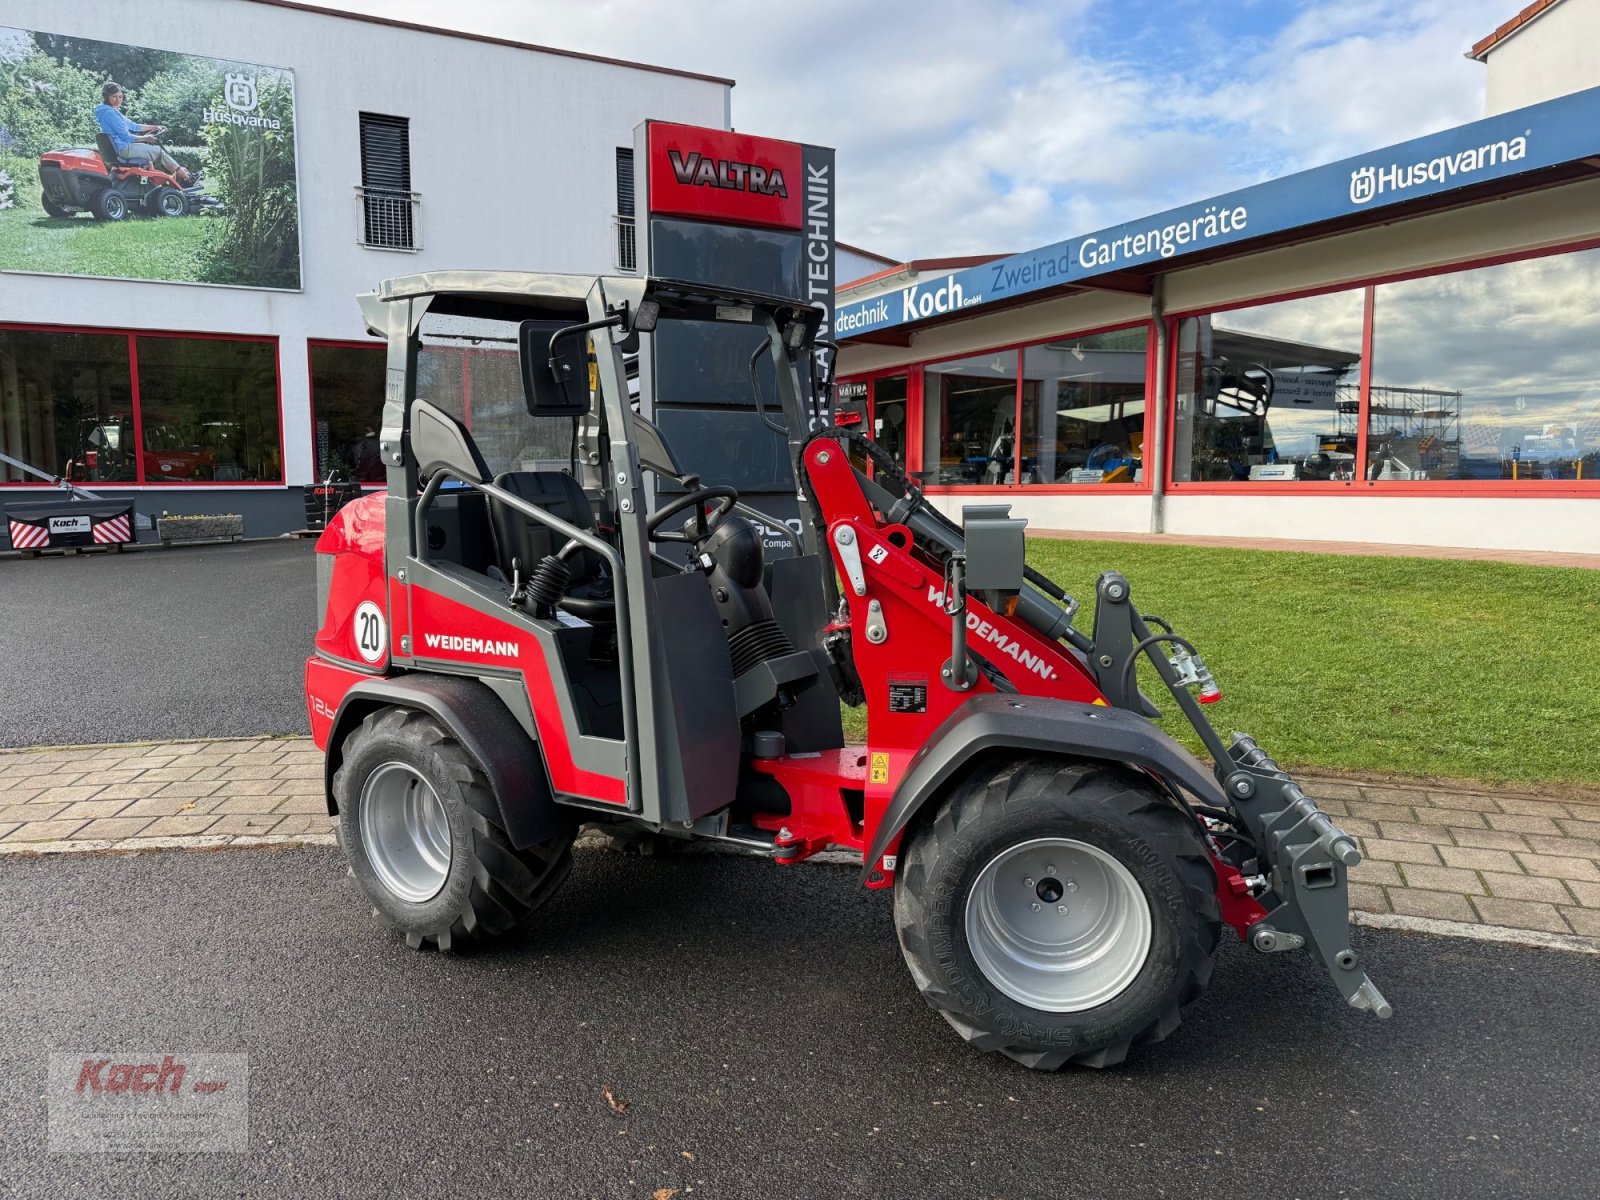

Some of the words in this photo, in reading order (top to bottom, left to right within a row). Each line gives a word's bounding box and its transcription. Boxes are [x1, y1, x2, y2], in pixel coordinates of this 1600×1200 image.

[203, 107, 281, 129] Husqvarna
[668, 150, 788, 198] VALTRA
[1378, 136, 1526, 194] Husqvarna
[835, 299, 889, 334] dtechnik
[903, 275, 963, 322] Koch
[963, 295, 982, 306] GmbH
[53, 519, 78, 527] Koch
[763, 538, 793, 550] Compa
[361, 612, 379, 651] 20
[425, 633, 519, 658] WEIDEMANN
[927, 585, 1053, 680] WDEMANN
